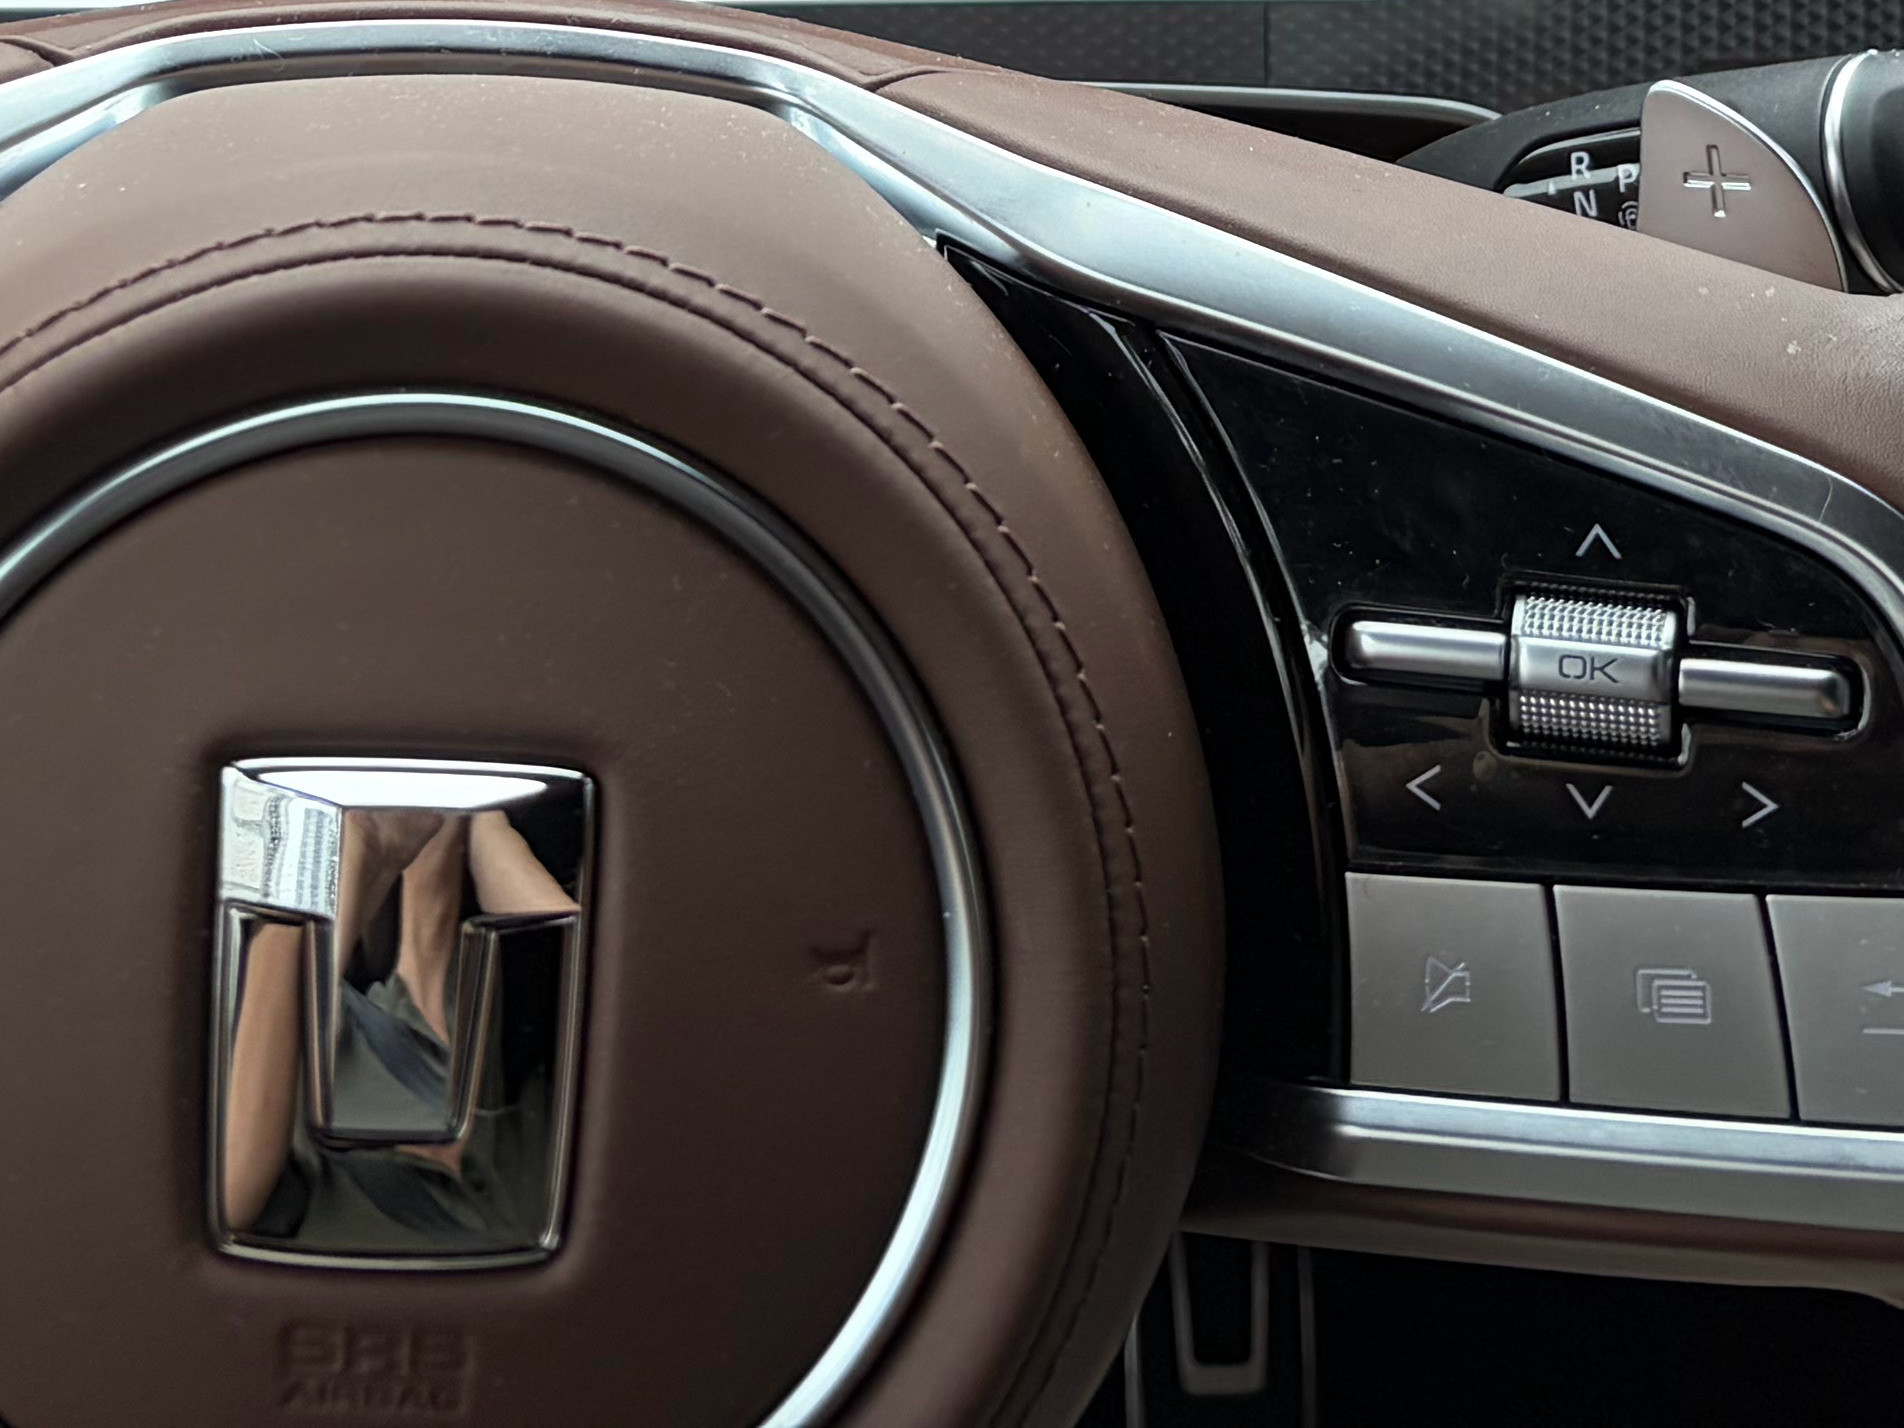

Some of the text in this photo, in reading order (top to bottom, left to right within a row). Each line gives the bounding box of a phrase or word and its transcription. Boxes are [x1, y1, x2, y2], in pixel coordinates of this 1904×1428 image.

[1570, 151, 1590, 180] R
[1573, 189, 1597, 220] N
[1557, 653, 1620, 685] OK
